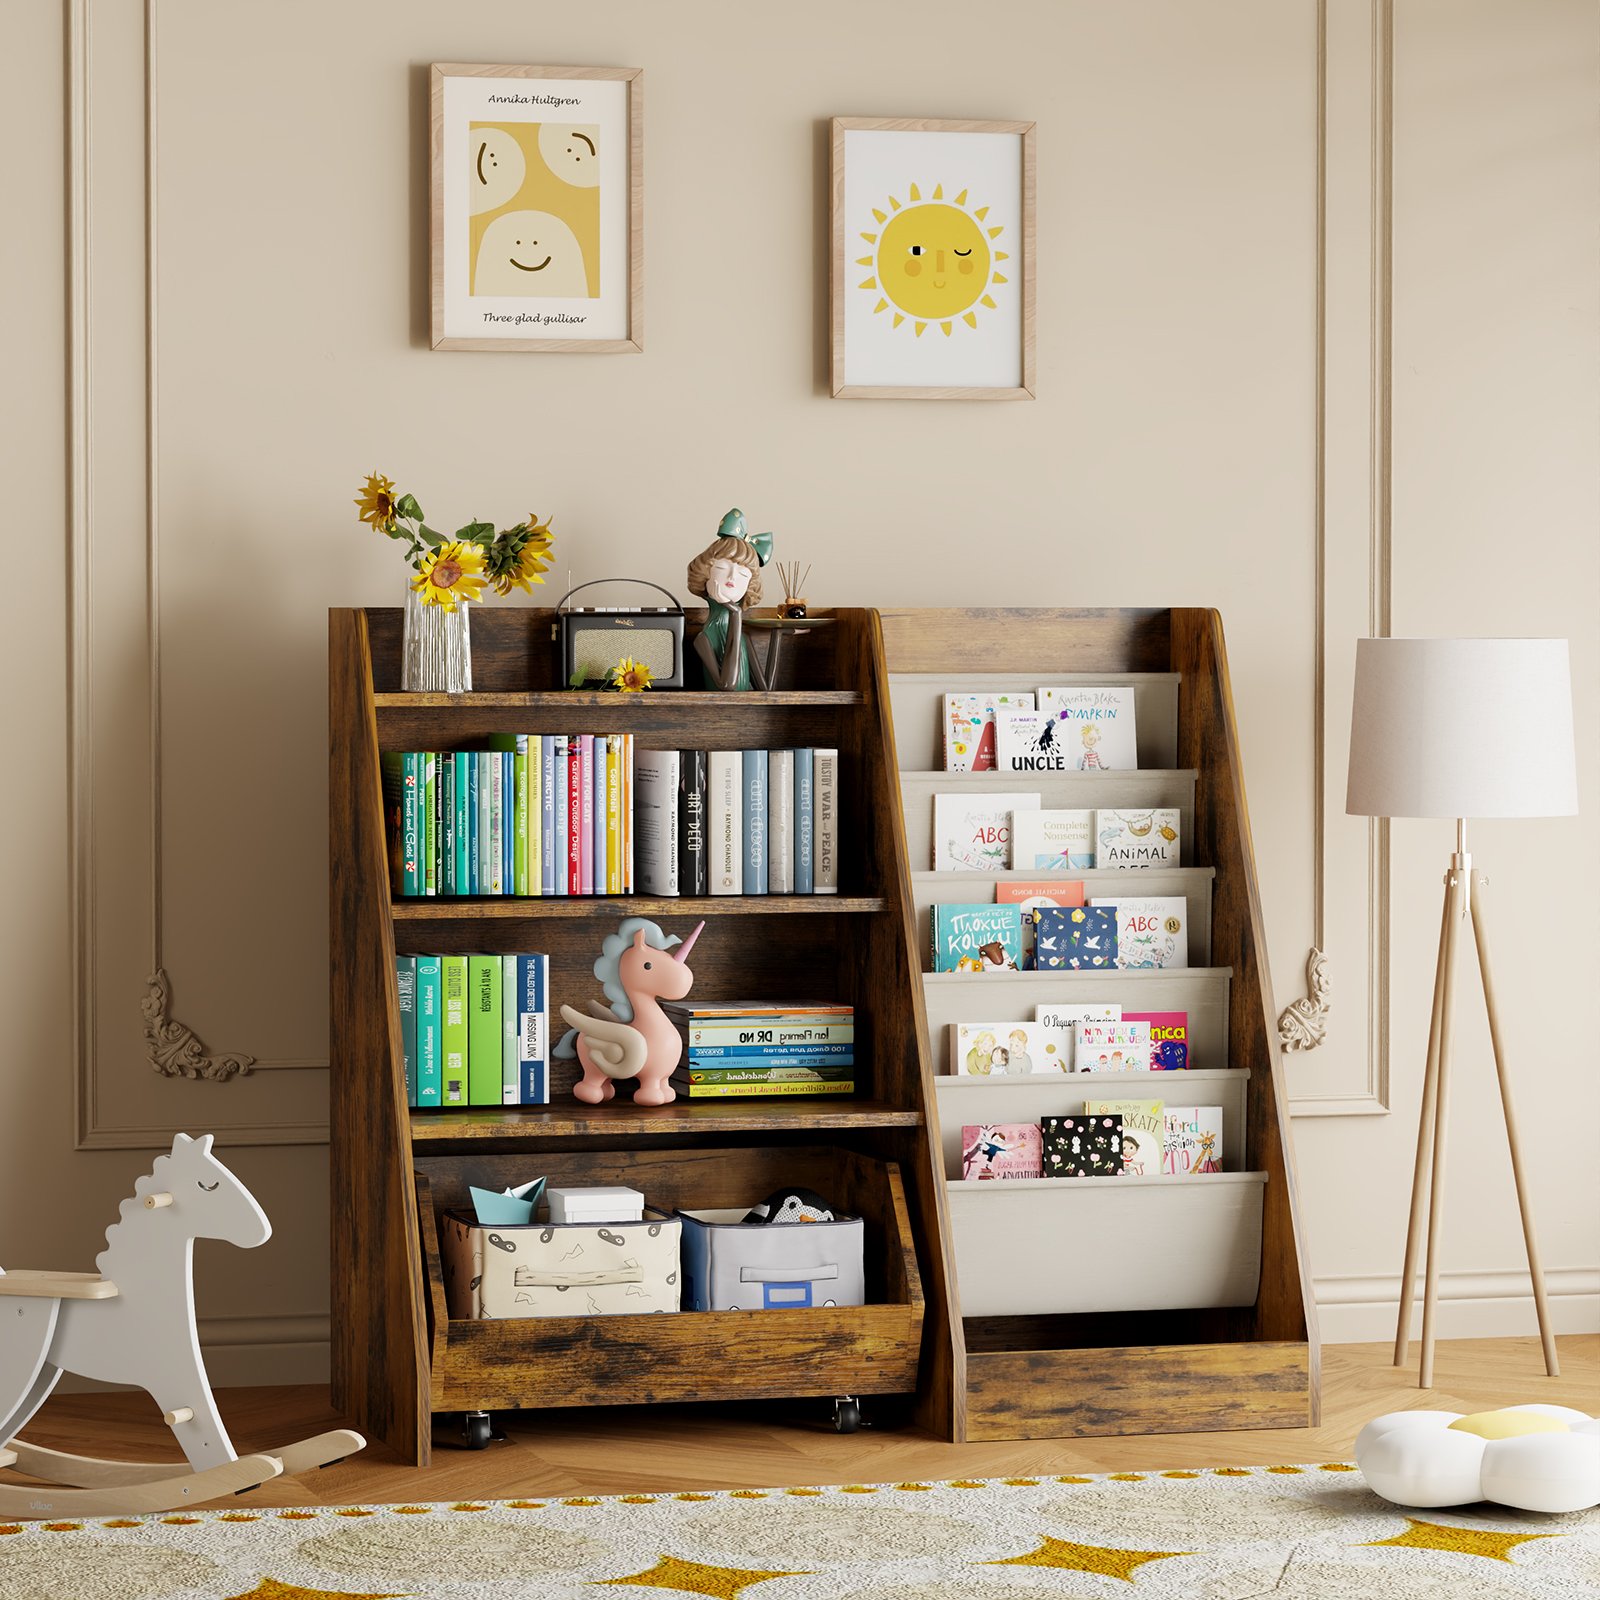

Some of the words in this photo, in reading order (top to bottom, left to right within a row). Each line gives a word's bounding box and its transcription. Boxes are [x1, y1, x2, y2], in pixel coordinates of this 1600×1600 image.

[488, 94, 529, 104] Annika
[531, 95, 581, 108] Hultgren
[483, 312, 514, 323] Three
[514, 312, 541, 325] glad
[544, 313, 587, 325] gullisar
[583, 751, 591, 784] LUXURY
[821, 759, 832, 787] TOLSTOY
[1012, 757, 1065, 771] UNCLE
[518, 771, 527, 810] Ecological
[545, 755, 553, 811] ANTARCTIC
[558, 762, 566, 800] Kitchen
[583, 785, 591, 801] FOR
[687, 792, 701, 815] ART
[750, 780, 763, 811] art
[801, 778, 811, 810] art
[822, 791, 831, 821] WAR
[519, 811, 527, 839] Design
[557, 804, 566, 836] Design
[1043, 821, 1089, 831] Complete
[687, 822, 701, 851] DECO
[972, 827, 1009, 844] ABC
[1043, 831, 1089, 841] Nonsense
[570, 836, 579, 862] Design
[822, 832, 831, 873] PEACE
[1125, 916, 1159, 933] ABC
[448, 966, 462, 977] LESS
[481, 968, 491, 978] ANS
[527, 959, 536, 970] THE
[396, 971, 414, 994] ELEANOR
[527, 970, 536, 988] PALEO
[399, 995, 413, 1013] RIGBY
[447, 999, 462, 1011] LESS
[480, 987, 491, 1012] RÉSISTANTS
[527, 988, 536, 1012] DIETER'S
[527, 1015, 537, 1042] MISSING
[1043, 1014, 1051, 1028] O
[1150, 1025, 1186, 1040] nica
[527, 1043, 537, 1059] LINK
[1123, 1112, 1161, 1133] SKATT
[1163, 1109, 1199, 1134] tford
